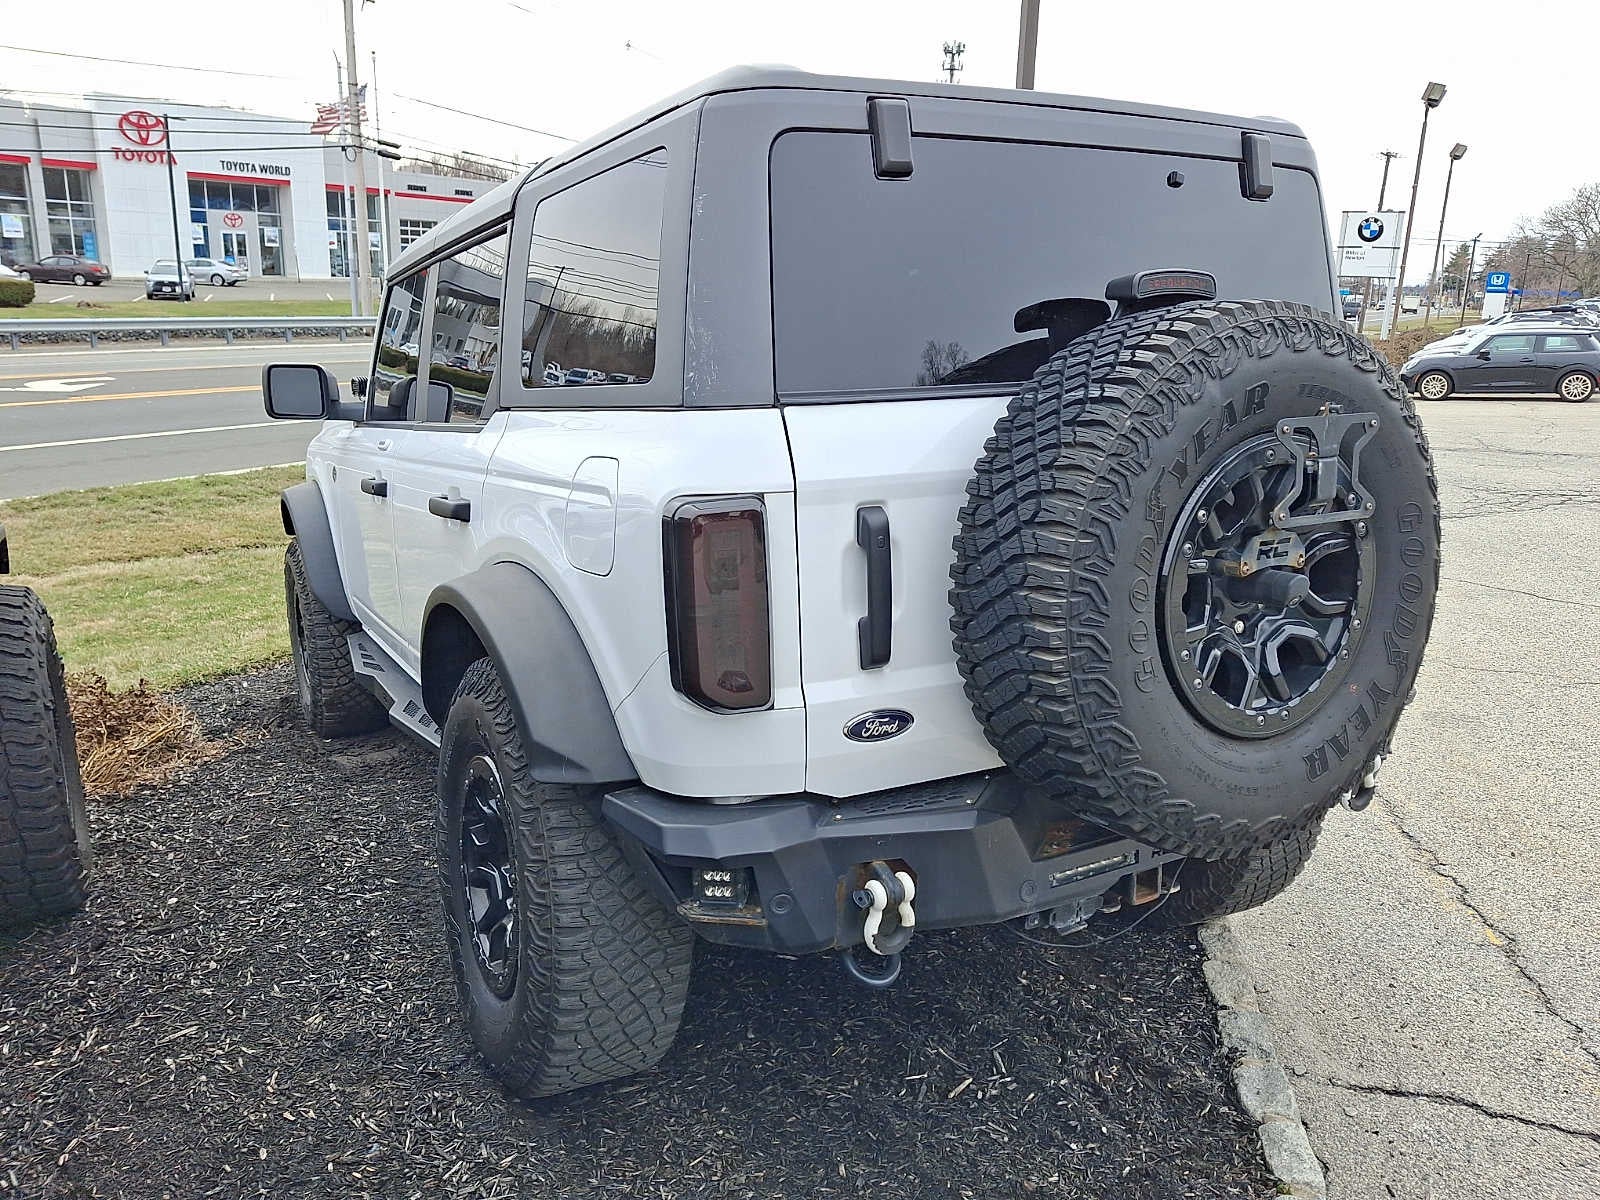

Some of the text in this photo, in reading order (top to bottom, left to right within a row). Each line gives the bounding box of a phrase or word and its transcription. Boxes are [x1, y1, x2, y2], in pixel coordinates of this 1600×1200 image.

[111, 147, 178, 166] TOYOTA
[219, 159, 291, 176] TOYOTA WORLD
[861, 716, 899, 738] Ford
